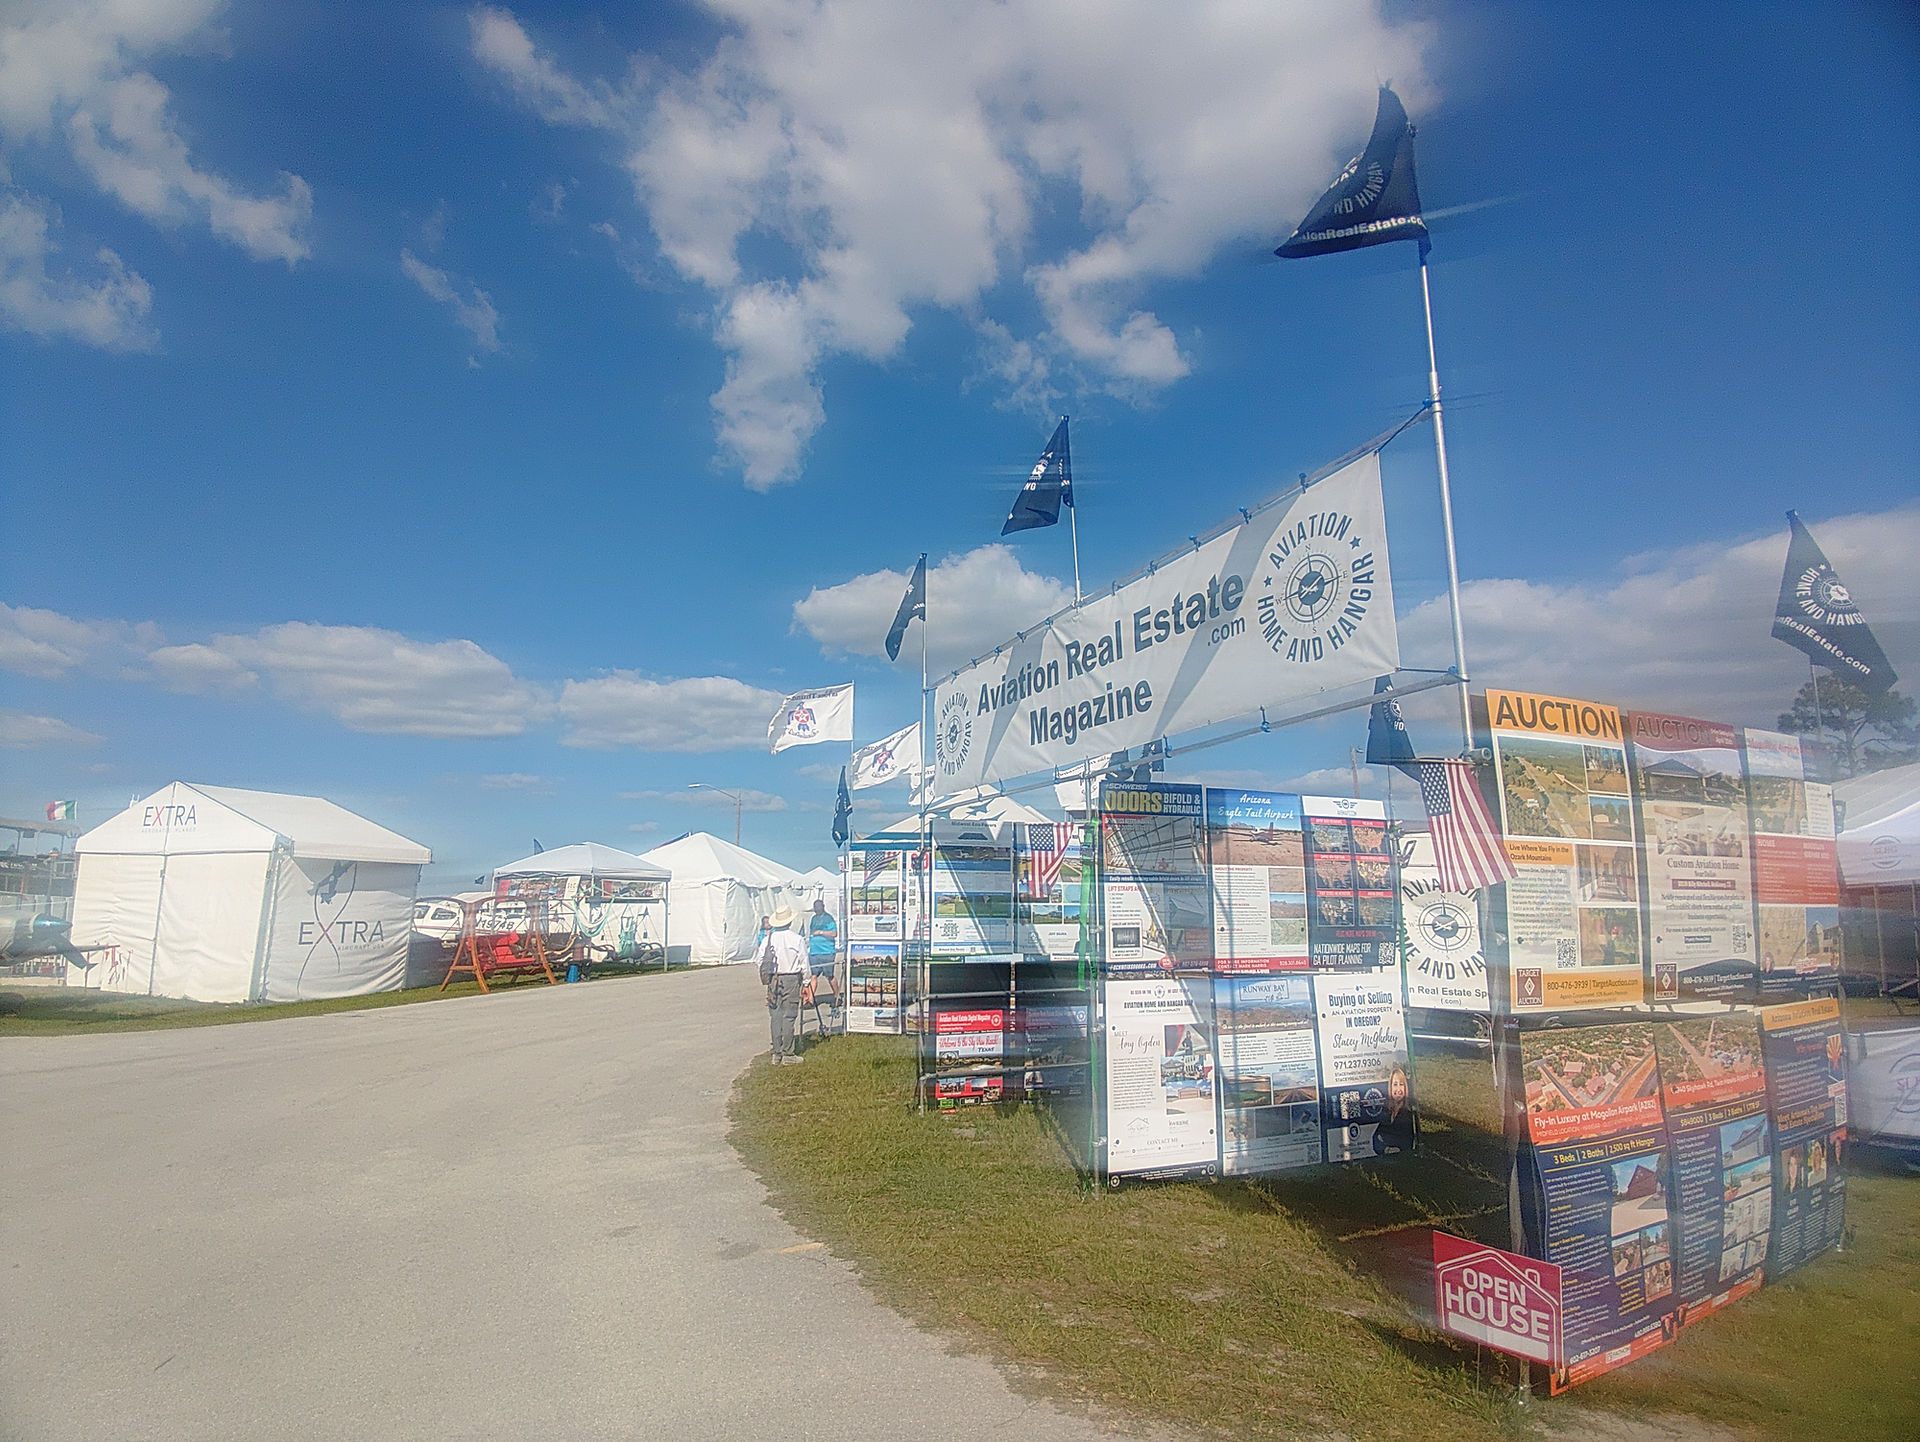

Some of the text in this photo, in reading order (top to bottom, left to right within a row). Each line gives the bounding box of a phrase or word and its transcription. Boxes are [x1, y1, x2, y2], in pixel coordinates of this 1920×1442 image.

[1269, 511, 1352, 570] AVIATION
[1796, 567, 1820, 597] HOME
[1257, 551, 1374, 662] HOME AND HANGAR
[1799, 599, 1825, 620] AND
[1207, 616, 1246, 647] .com
[976, 574, 1243, 717] Aviation Real Estate
[942, 692, 968, 719] AVIATION
[1029, 679, 1153, 746] Magazine
[1496, 695, 1619, 739] AUCTION
[1636, 717, 1711, 744] AUCTION
[956, 720, 972, 771] HANGAR
[1105, 791, 1162, 812] DOORS
[1163, 804, 1200, 814] HYDRAULIC
[1164, 793, 1200, 804] BIFOLD &
[1240, 793, 1272, 804] Arizona
[143, 805, 197, 826] EXTRA
[1218, 806, 1294, 820] Eagle Tail Airpark
[1667, 858, 1739, 869] Custom Aviation Home
[299, 920, 385, 945] EXTRA
[1314, 943, 1371, 954] NATIONWIDE MAPS FOR
[1322, 955, 1338, 965] PILOT
[1339, 954, 1363, 965] PLANNING
[1417, 957, 1455, 980] AND
[1518, 969, 1540, 977] TARGET
[1243, 984, 1285, 993] RUNWAY BAY
[1417, 986, 1472, 997] Real Estate
[1547, 978, 1638, 990] 800-476-3939 TargetAuction.com
[1328, 991, 1393, 1008] Buying or Selling
[1518, 997, 1541, 1005] AUCTION
[1345, 1015, 1381, 1028] IN OREGON?
[1333, 1034, 1359, 1051] Stacey
[1334, 1058, 1381, 1070] 971.237.9306
[1534, 1116, 1556, 1129] Fly-In
[1556, 1112, 1581, 1125] Luxury
[1618, 1105, 1638, 1115] Airpark
[1553, 1155, 1560, 1164] 3
[1559, 1152, 1575, 1163] Beds
[1582, 1151, 1587, 1159] 2
[1587, 1148, 1604, 1159] Baths
[1623, 1143, 1630, 1151] sq
[1630, 1141, 1636, 1149] ft
[1636, 1137, 1655, 1148] Hangar
[1462, 1268, 1526, 1306] OPEN
[1445, 1281, 1550, 1342] HOUSE
